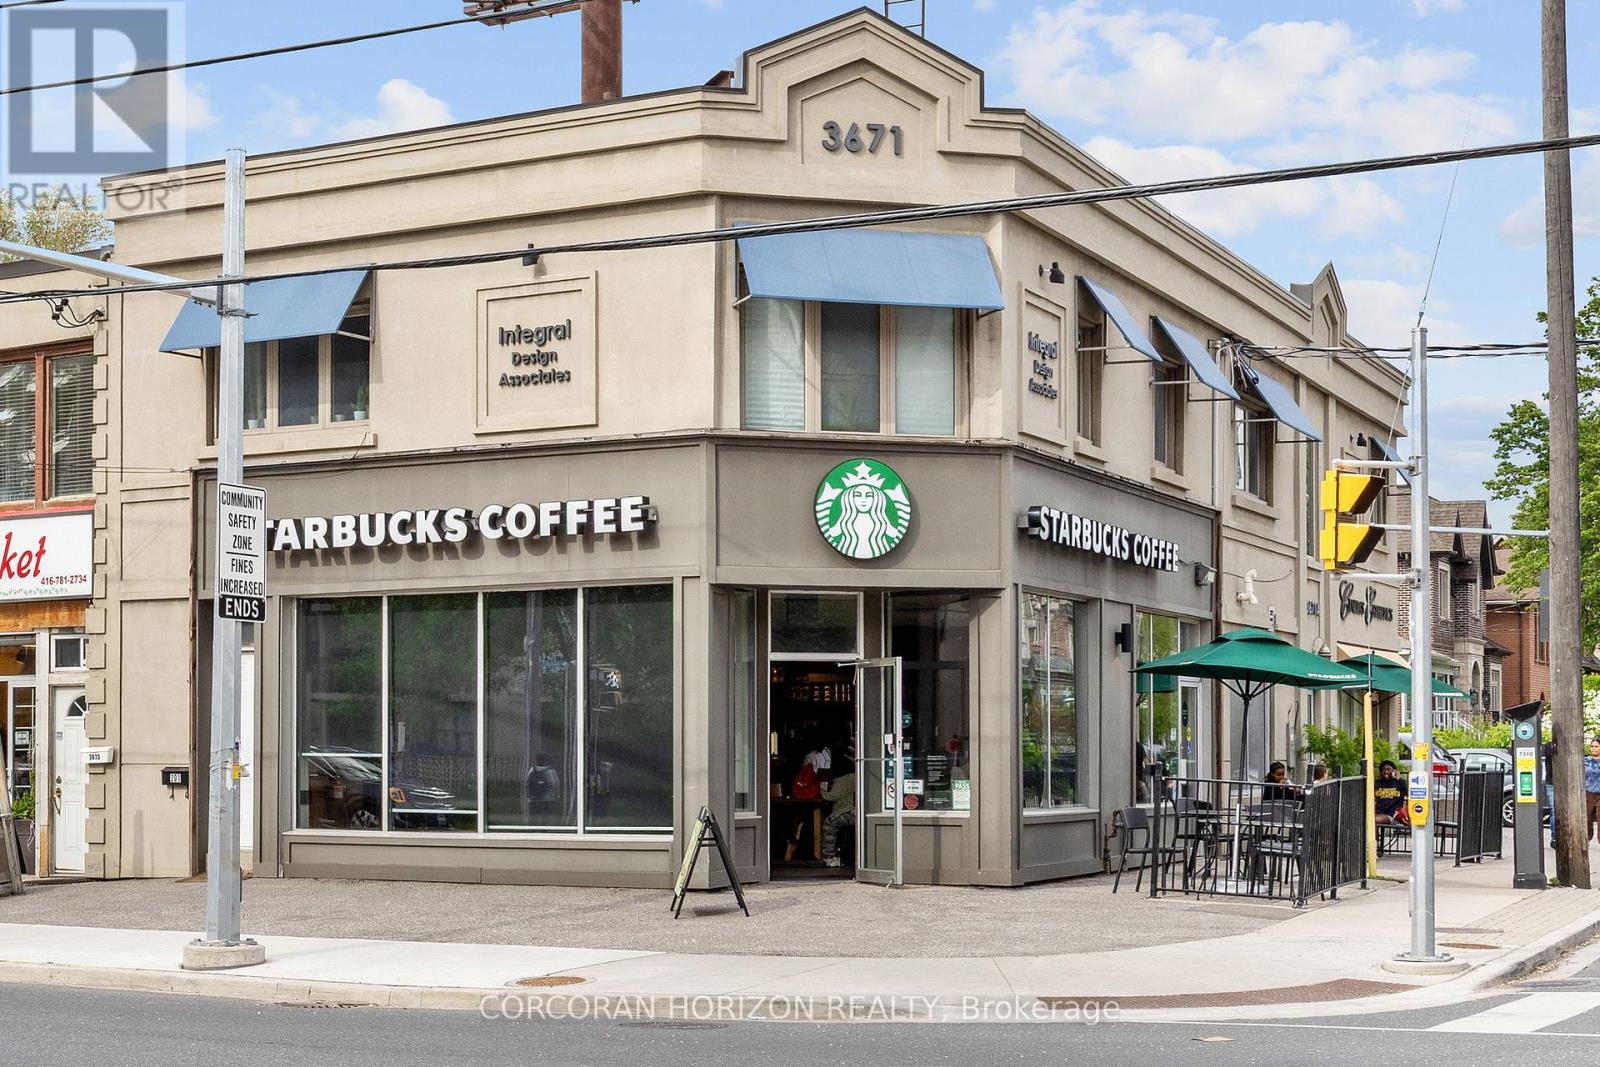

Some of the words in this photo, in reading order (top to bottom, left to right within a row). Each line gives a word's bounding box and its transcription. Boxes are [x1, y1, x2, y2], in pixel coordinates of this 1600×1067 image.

[822, 120, 904, 157] 3671
[498, 318, 572, 347] Integral
[511, 349, 559, 367] Design
[498, 368, 571, 388] Associates
[221, 490, 264, 511] COMMUNITY
[228, 512, 257, 530] SAFETY
[267, 507, 468, 552] ARBUCKS
[478, 496, 647, 540] COFFEE
[232, 534, 253, 551] ZONE
[1039, 505, 1129, 561] STARBUCKS
[1133, 533, 1179, 573] COFFEE
[230, 558, 254, 574] FINES
[41, 574, 87, 586] 416-781-2734
[220, 577, 264, 596] INCREASED
[225, 597, 260, 618] ENDS
